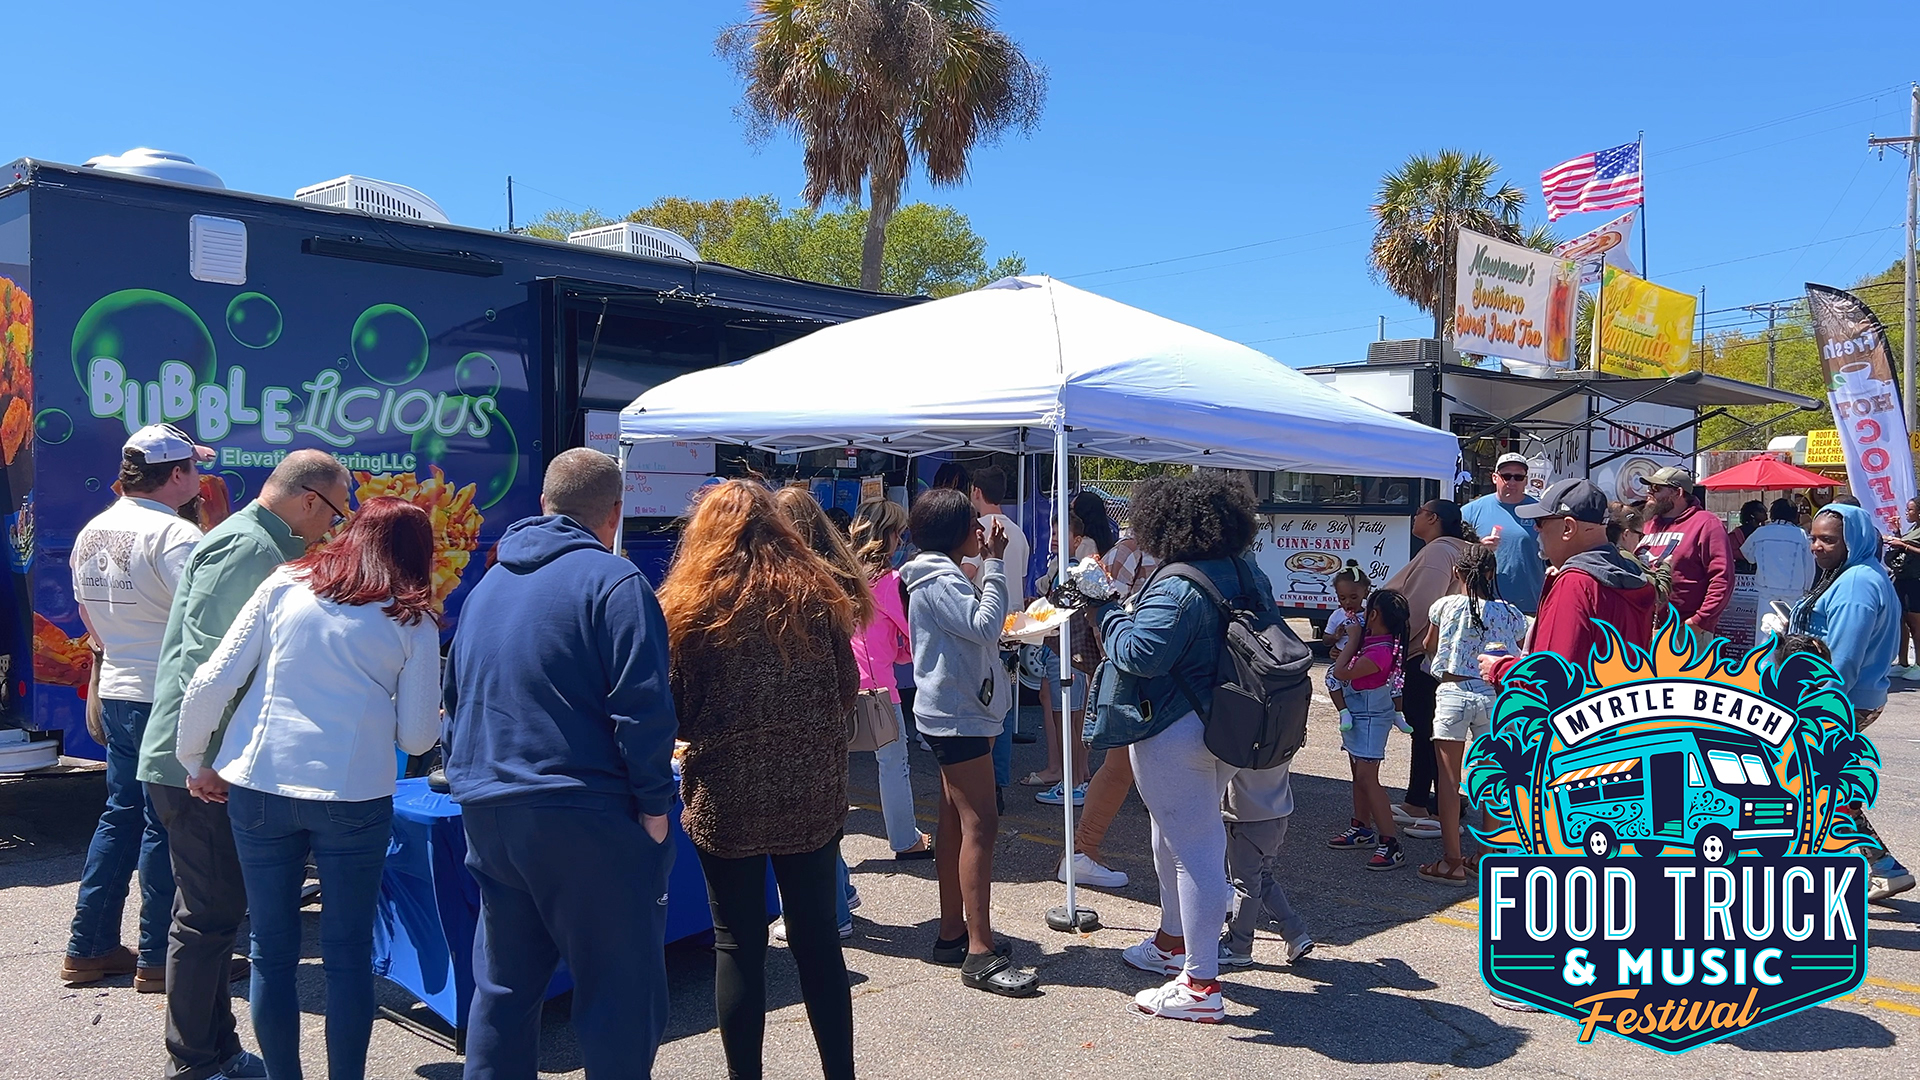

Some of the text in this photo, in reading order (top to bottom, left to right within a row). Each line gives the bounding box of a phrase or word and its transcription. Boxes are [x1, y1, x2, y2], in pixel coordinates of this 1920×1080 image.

[1468, 243, 1535, 286] Mawmaw's
[1472, 277, 1525, 315] Southern
[1456, 304, 1543, 349] Sweet Iced Tea
[87, 356, 497, 447] BUBBLE LICIOUS
[1815, 431, 1831, 439] ROOT
[221, 448, 286, 466] Elevati
[1553, 431, 1580, 475] of the
[1807, 455, 1845, 463] ORANGE CREA
[1808, 447, 1843, 455] BLACK CHER
[1280, 520, 1294, 532] of
[1301, 519, 1318, 531] the
[1327, 520, 1348, 534] Big
[1358, 521, 1386, 535] Fatty
[1277, 537, 1350, 550] CINN-SANE
[1373, 538, 1385, 556] A
[1368, 561, 1390, 580] Big
[1280, 593, 1318, 602] CINNAMON
